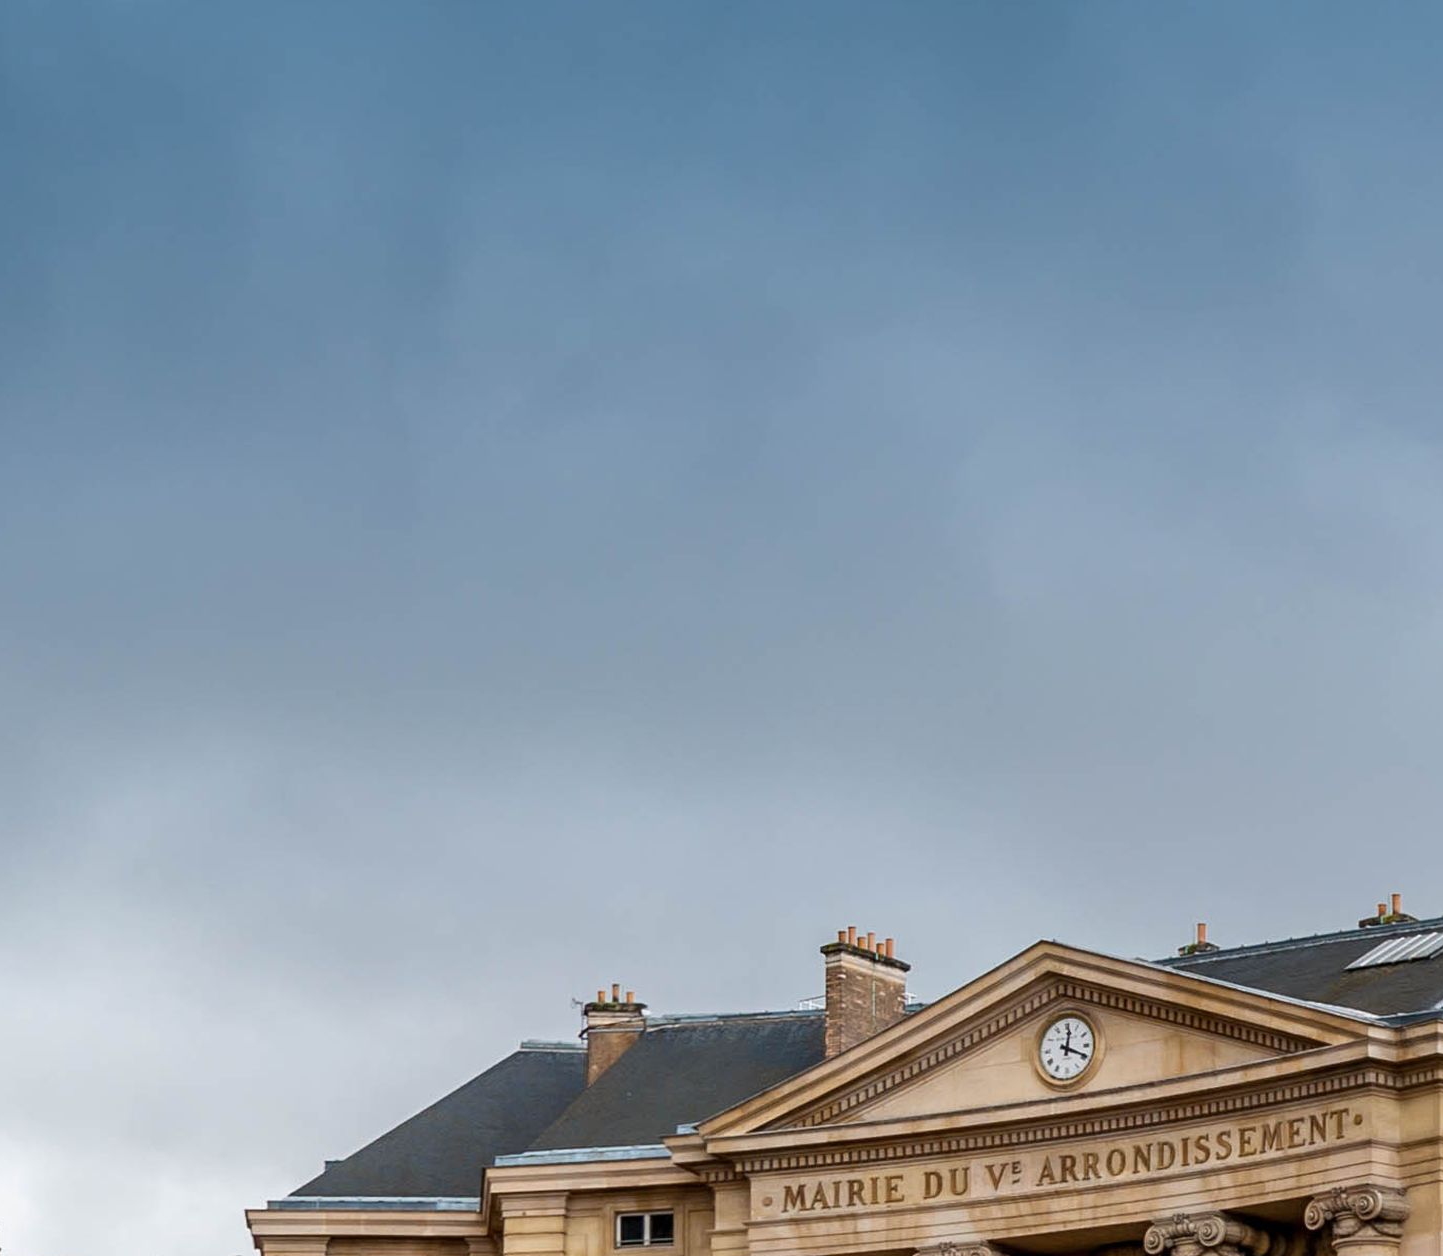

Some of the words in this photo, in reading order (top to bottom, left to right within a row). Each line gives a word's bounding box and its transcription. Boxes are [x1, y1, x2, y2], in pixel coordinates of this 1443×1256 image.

[781, 1174, 905, 1213] MAIRIE
[922, 1166, 972, 1200] DU
[1035, 1107, 1351, 1187] ARRONDISSEMENT
